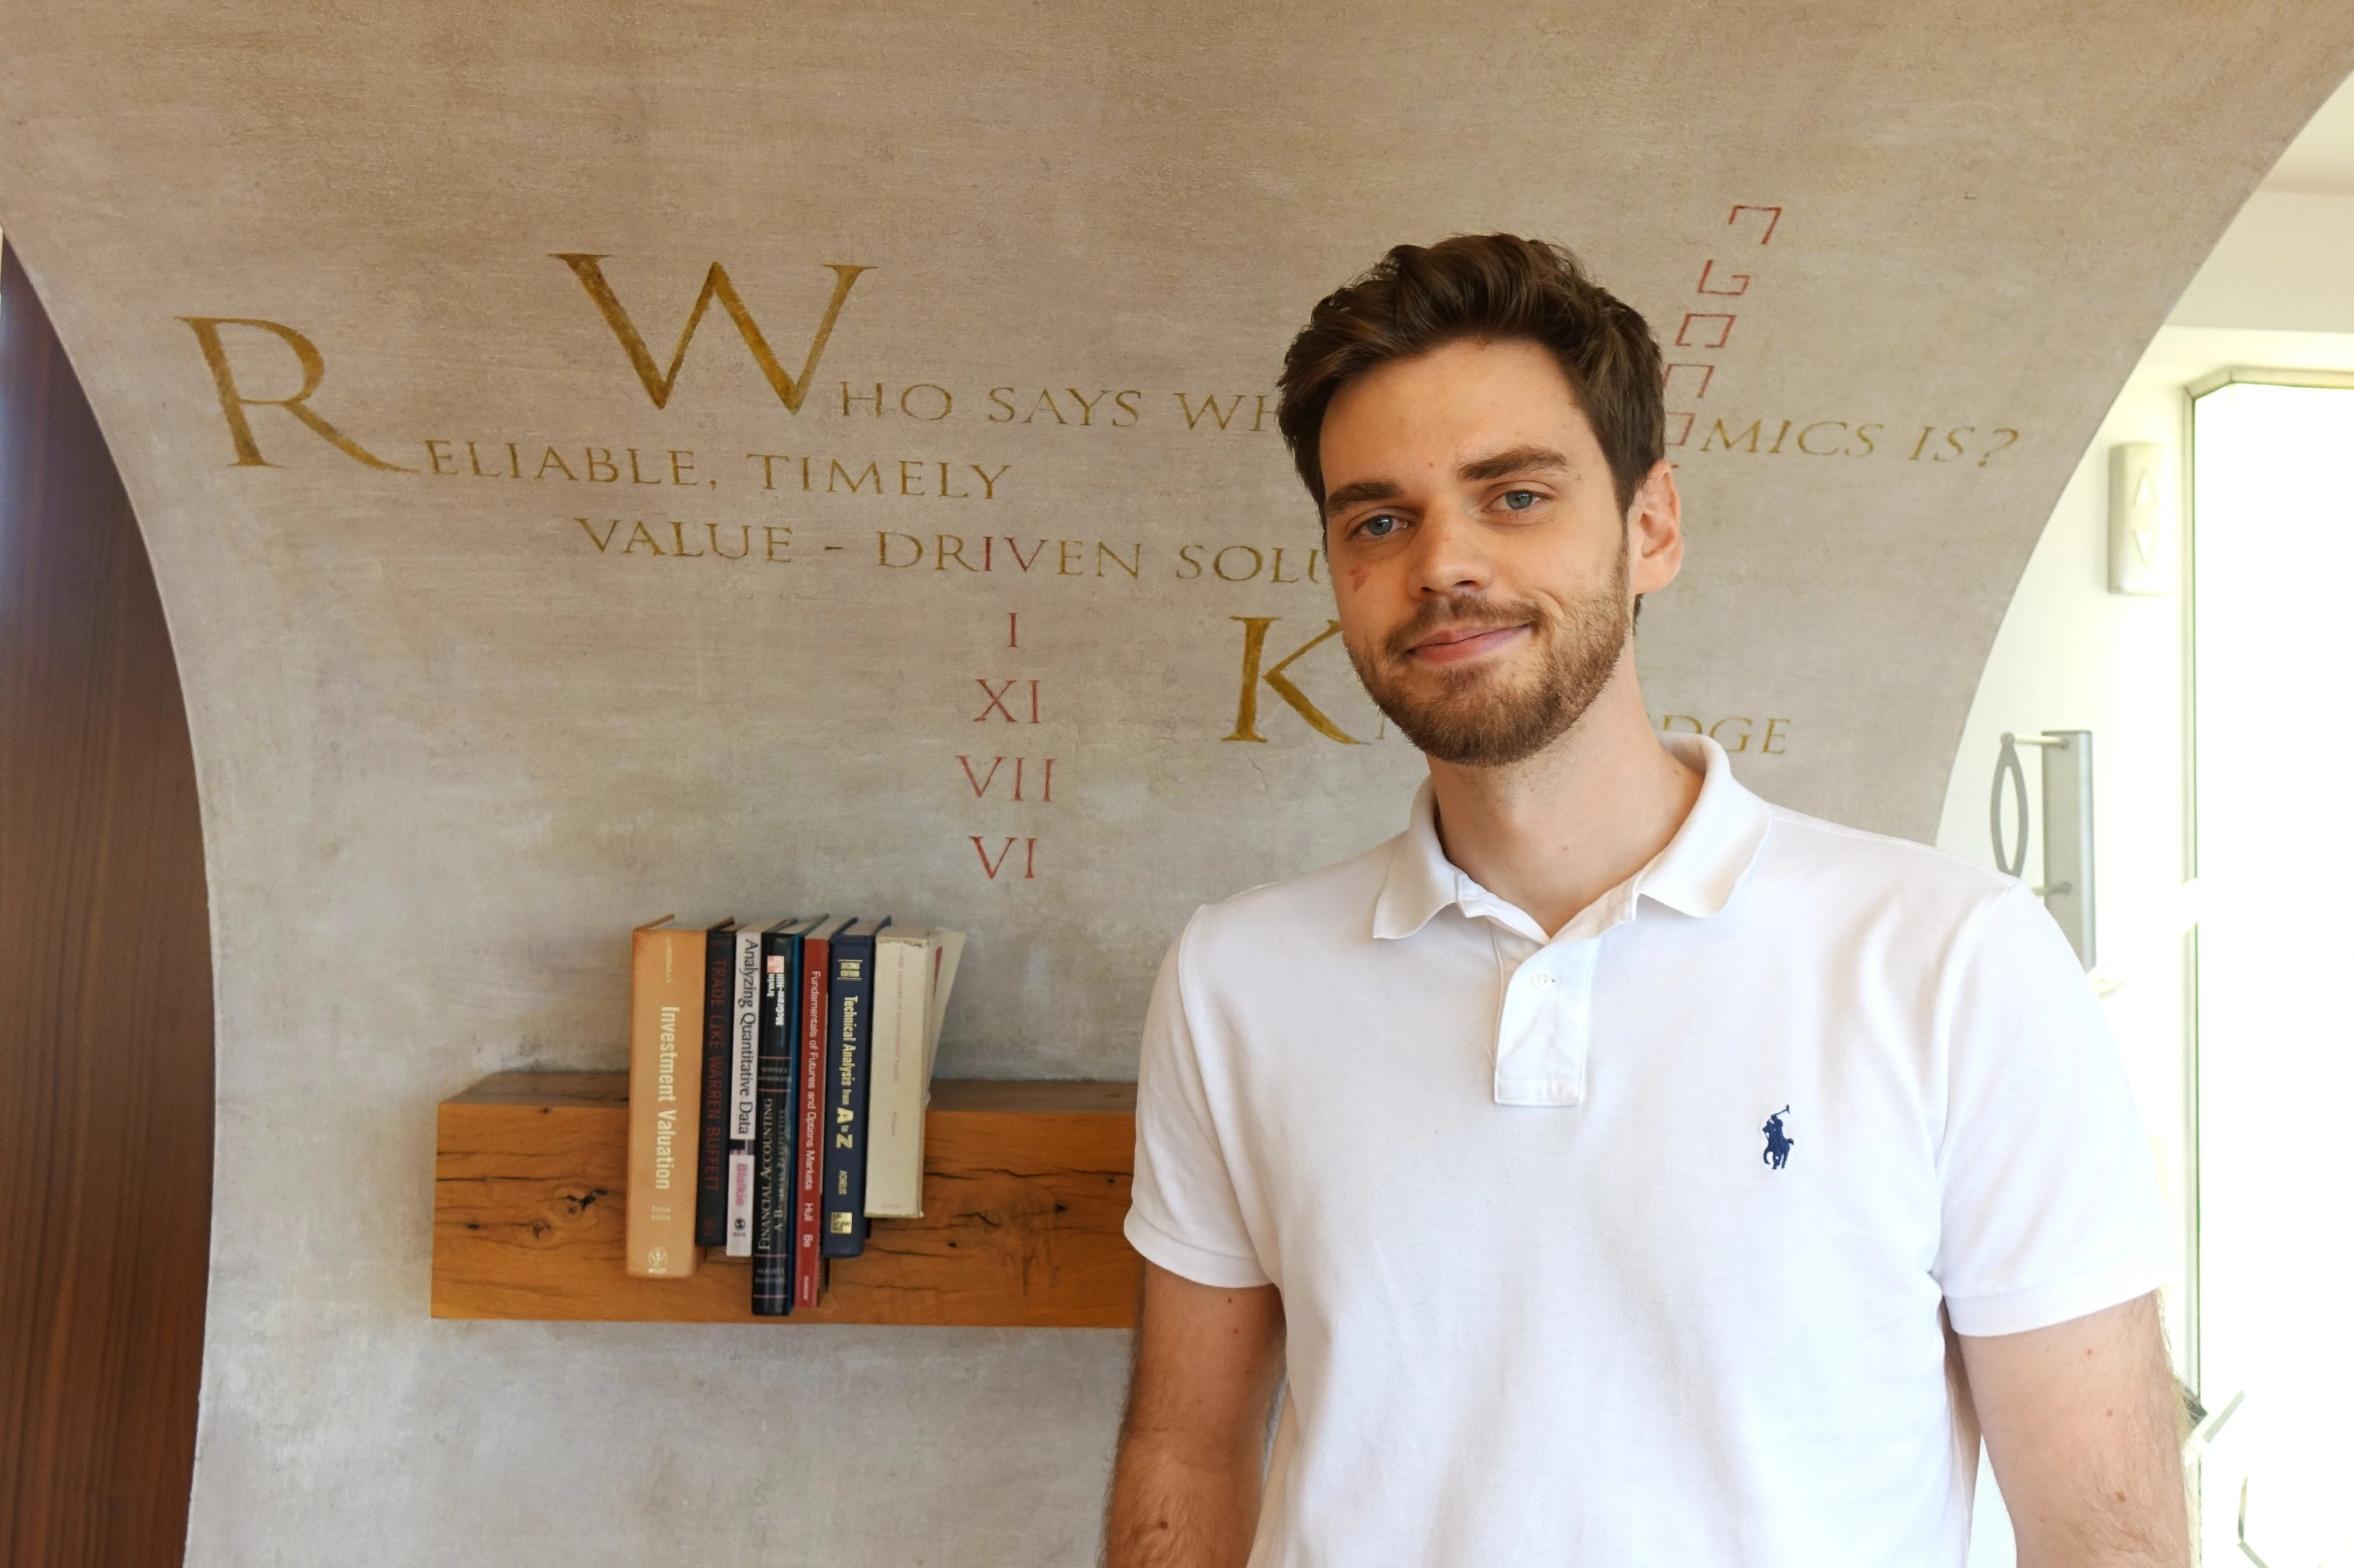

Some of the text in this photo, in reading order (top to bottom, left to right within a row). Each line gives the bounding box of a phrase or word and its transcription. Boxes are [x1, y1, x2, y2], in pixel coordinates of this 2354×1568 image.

[987, 385, 1143, 428] SAYS
[1908, 425, 2020, 468] IS?
[746, 452, 1013, 501] TIMELY
[575, 518, 792, 563] VALUE
[876, 531, 1143, 579] DRIVEN
[1008, 612, 1019, 648] I
[974, 679, 1042, 724] XI
[955, 755, 1055, 802] VII
[968, 835, 1038, 880] VI
[711, 959, 727, 1007] TRADE
[775, 974, 785, 1026] McGraw-Hill
[809, 971, 821, 1038] Fundamentals
[709, 1015, 724, 1048] LIKE
[738, 938, 759, 1134] Analyzing Quantitative Data
[843, 996, 858, 1042] Technical
[809, 1040, 817, 1051] of
[839, 1044, 857, 1087] Analysis
[706, 1056, 723, 1120] WARREN
[808, 1052, 819, 1088] Futures
[656, 1006, 680, 1189] Investment Valuation
[808, 1091, 816, 1109] and
[837, 1107, 854, 1124] A
[805, 1112, 817, 1147] Options
[836, 1134, 854, 1149] Z
[704, 1126, 720, 1192] BUFFETT
[805, 1150, 816, 1191] Markets
[804, 1203, 814, 1222] Hull
